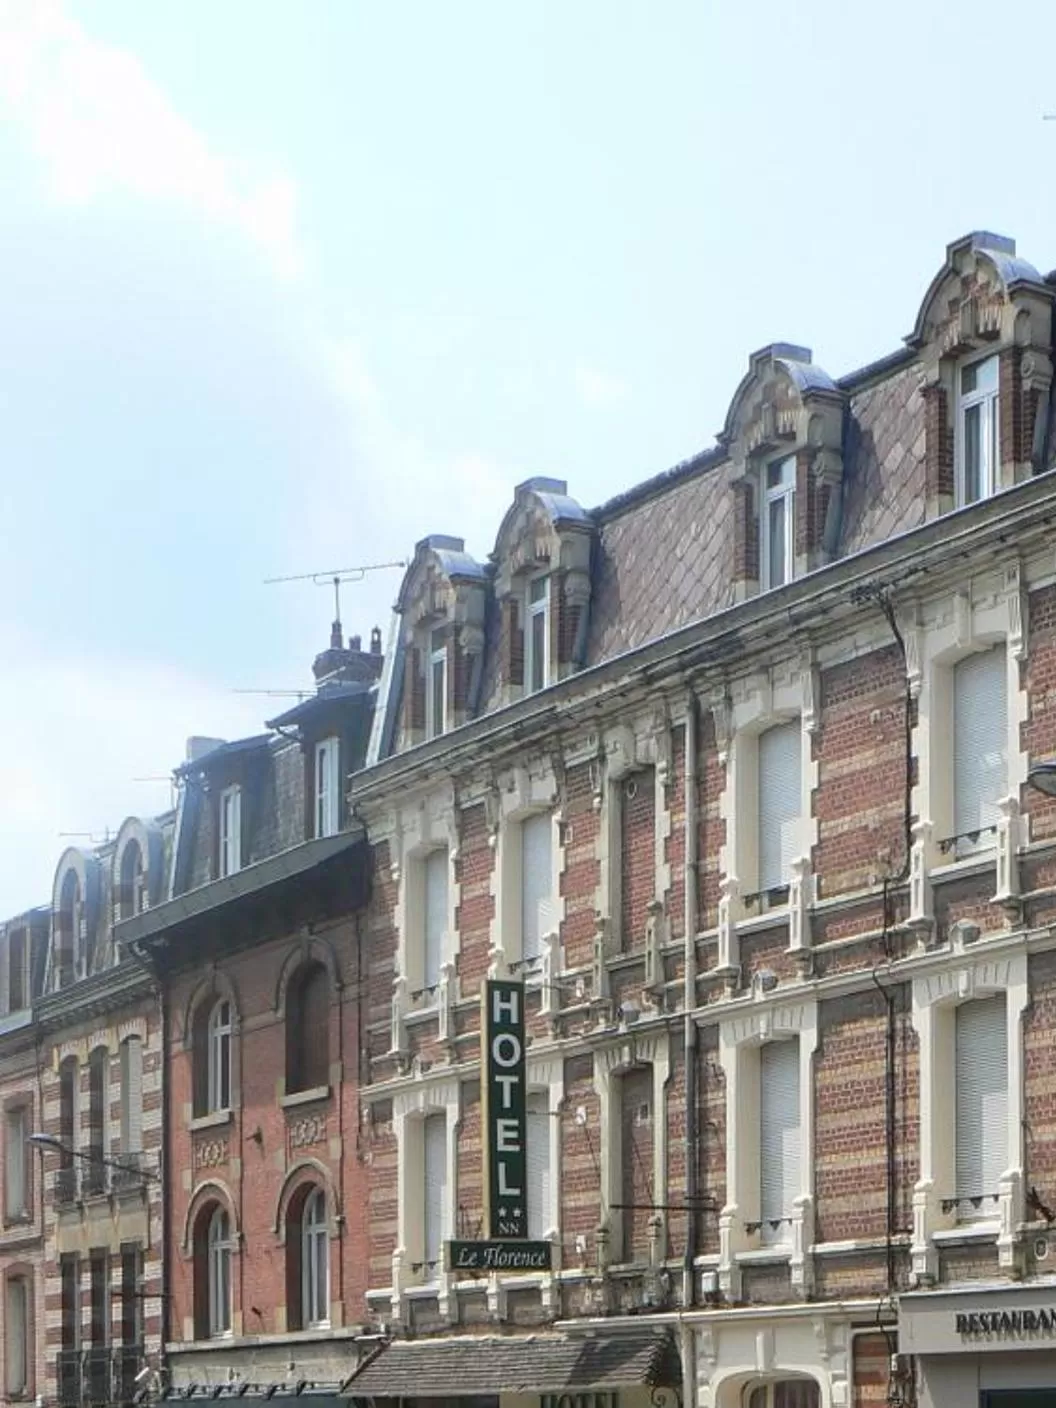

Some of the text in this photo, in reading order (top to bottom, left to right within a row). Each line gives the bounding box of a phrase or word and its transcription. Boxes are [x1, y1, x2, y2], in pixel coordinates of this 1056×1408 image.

[492, 990, 522, 1196] HOTEL
[456, 1244, 545, 1268] Le Florence
